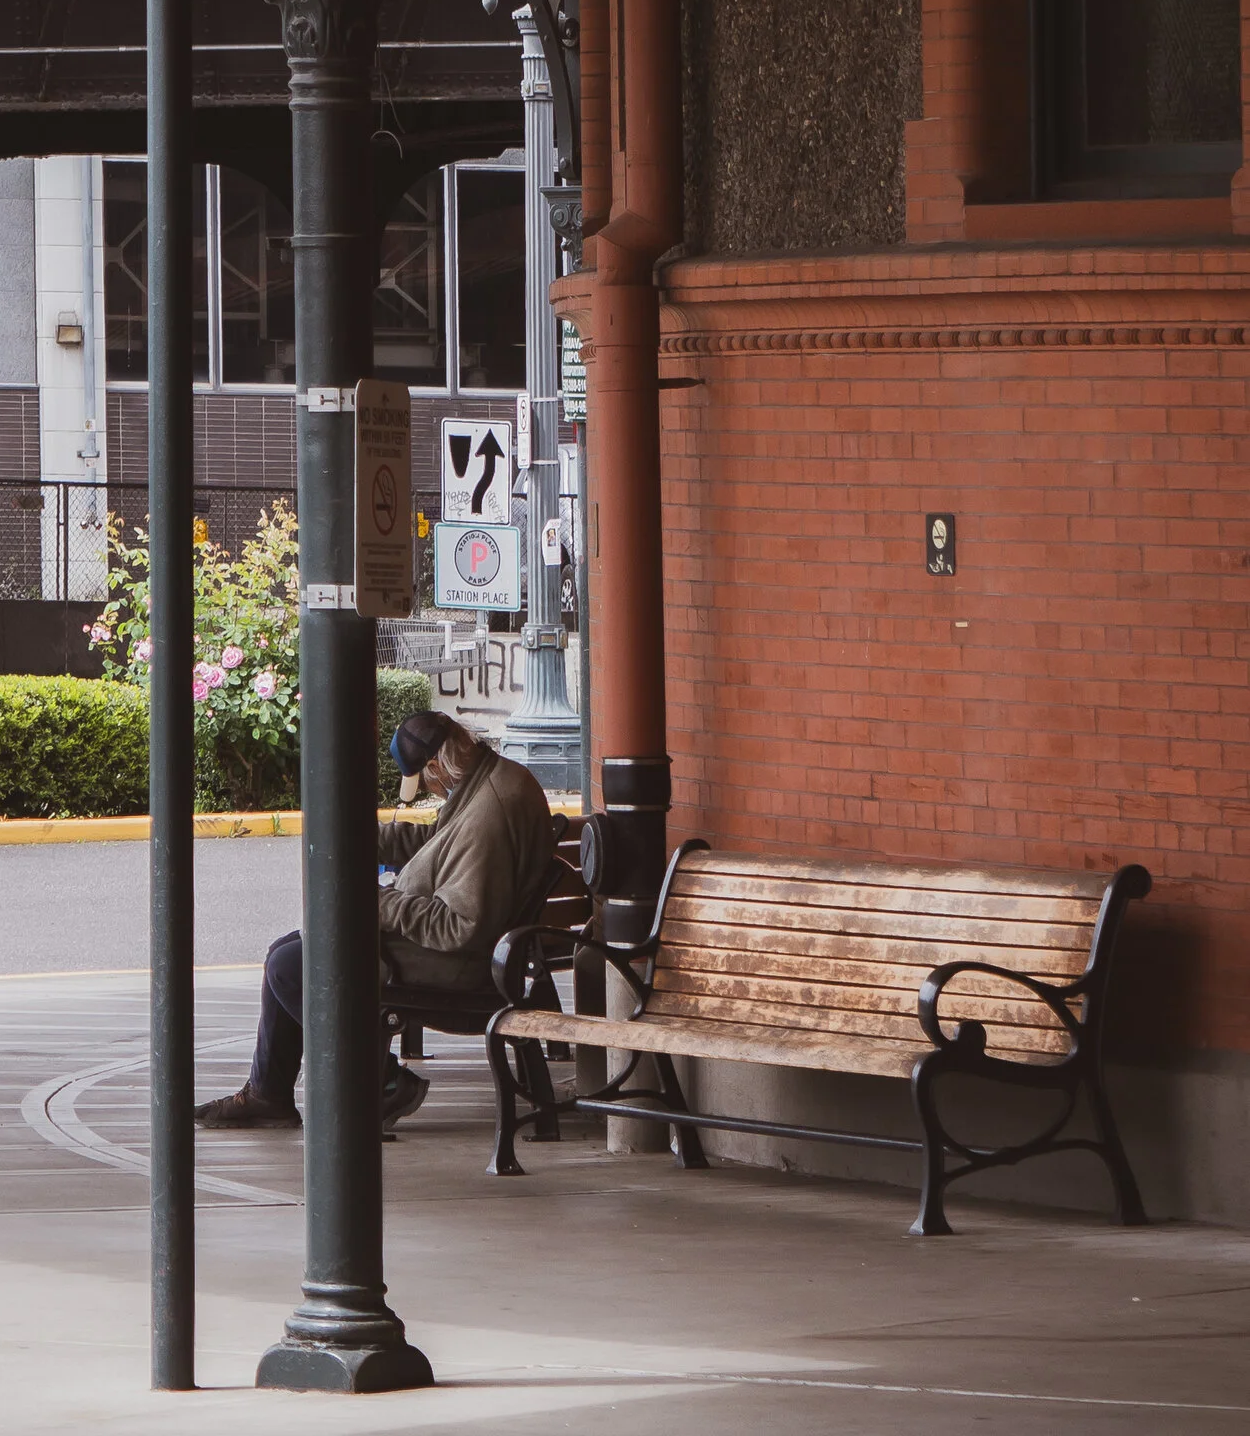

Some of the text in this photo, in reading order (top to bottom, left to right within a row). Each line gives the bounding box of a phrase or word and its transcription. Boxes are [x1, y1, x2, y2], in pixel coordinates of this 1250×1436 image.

[359, 407, 409, 428] NO SMOKING
[459, 533, 497, 554] STATION PLACE
[471, 542, 488, 573] P
[468, 576, 488, 584] PARK
[446, 590, 508, 604] STATION PLACE
